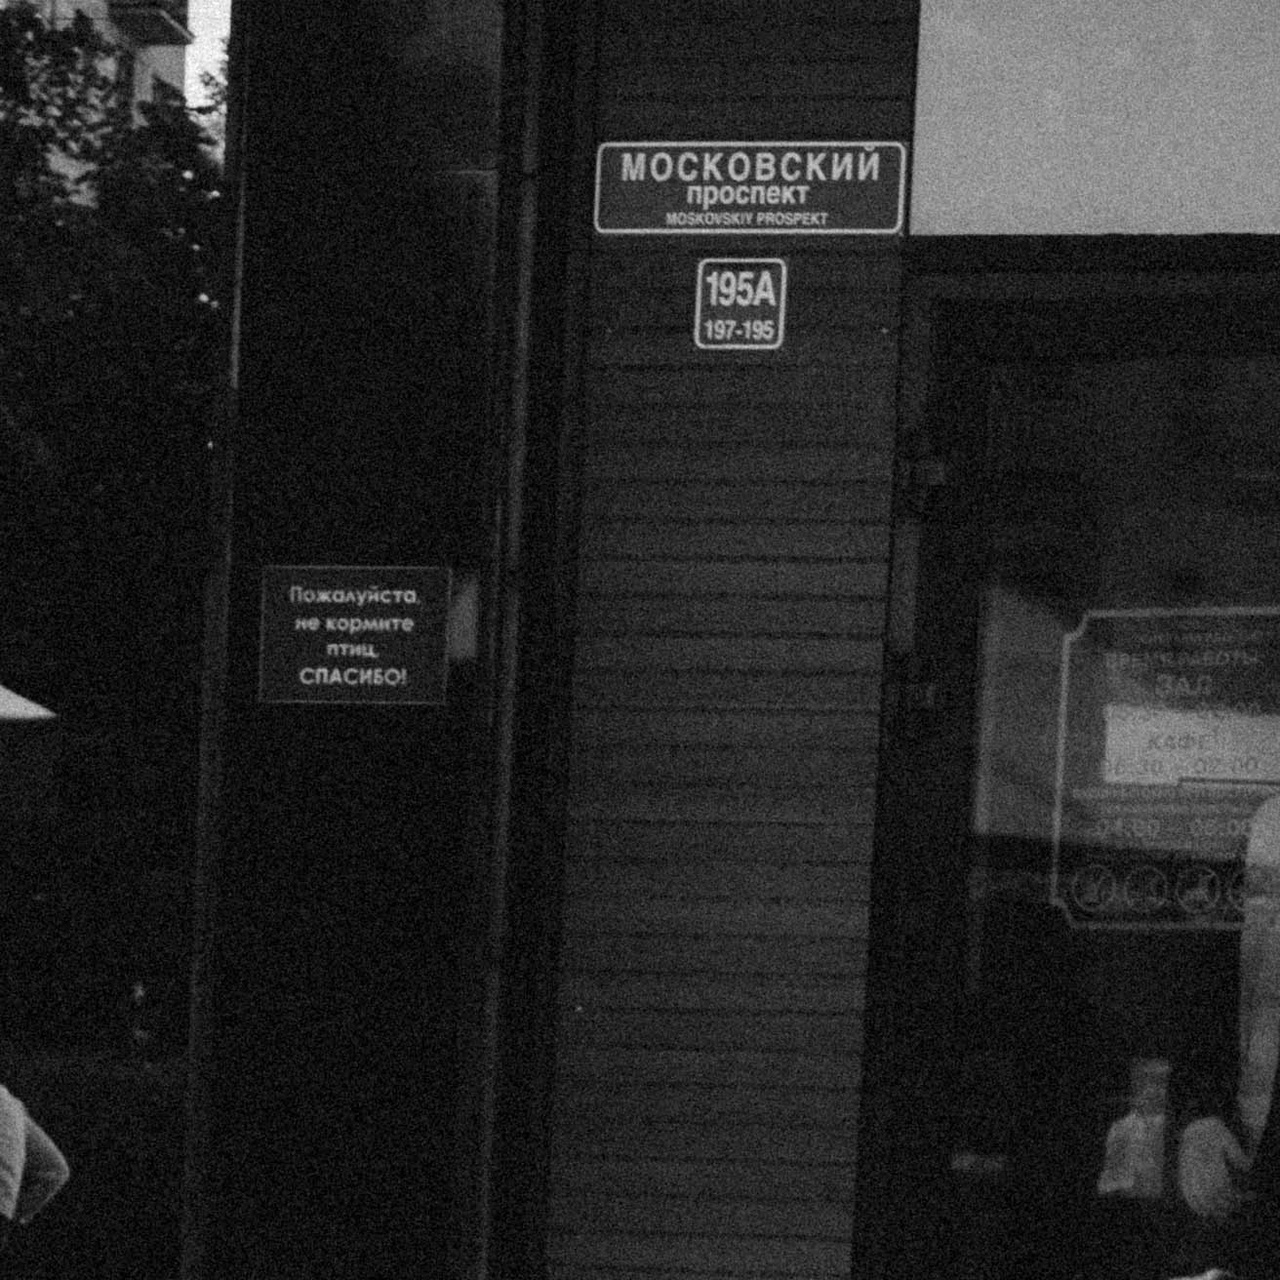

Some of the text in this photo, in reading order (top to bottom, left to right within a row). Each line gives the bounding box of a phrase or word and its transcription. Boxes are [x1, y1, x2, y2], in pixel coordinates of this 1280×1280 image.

[620, 146, 880, 182] МОСКОВСКИЙ
[686, 185, 811, 211] проспект
[666, 212, 829, 226] MOSKOVSKIY PROSPEKT
[705, 270, 777, 307] 195А
[703, 319, 776, 341] 197-195
[294, 617, 415, 634] не кормите
[299, 667, 408, 687] СПАСИБО!
